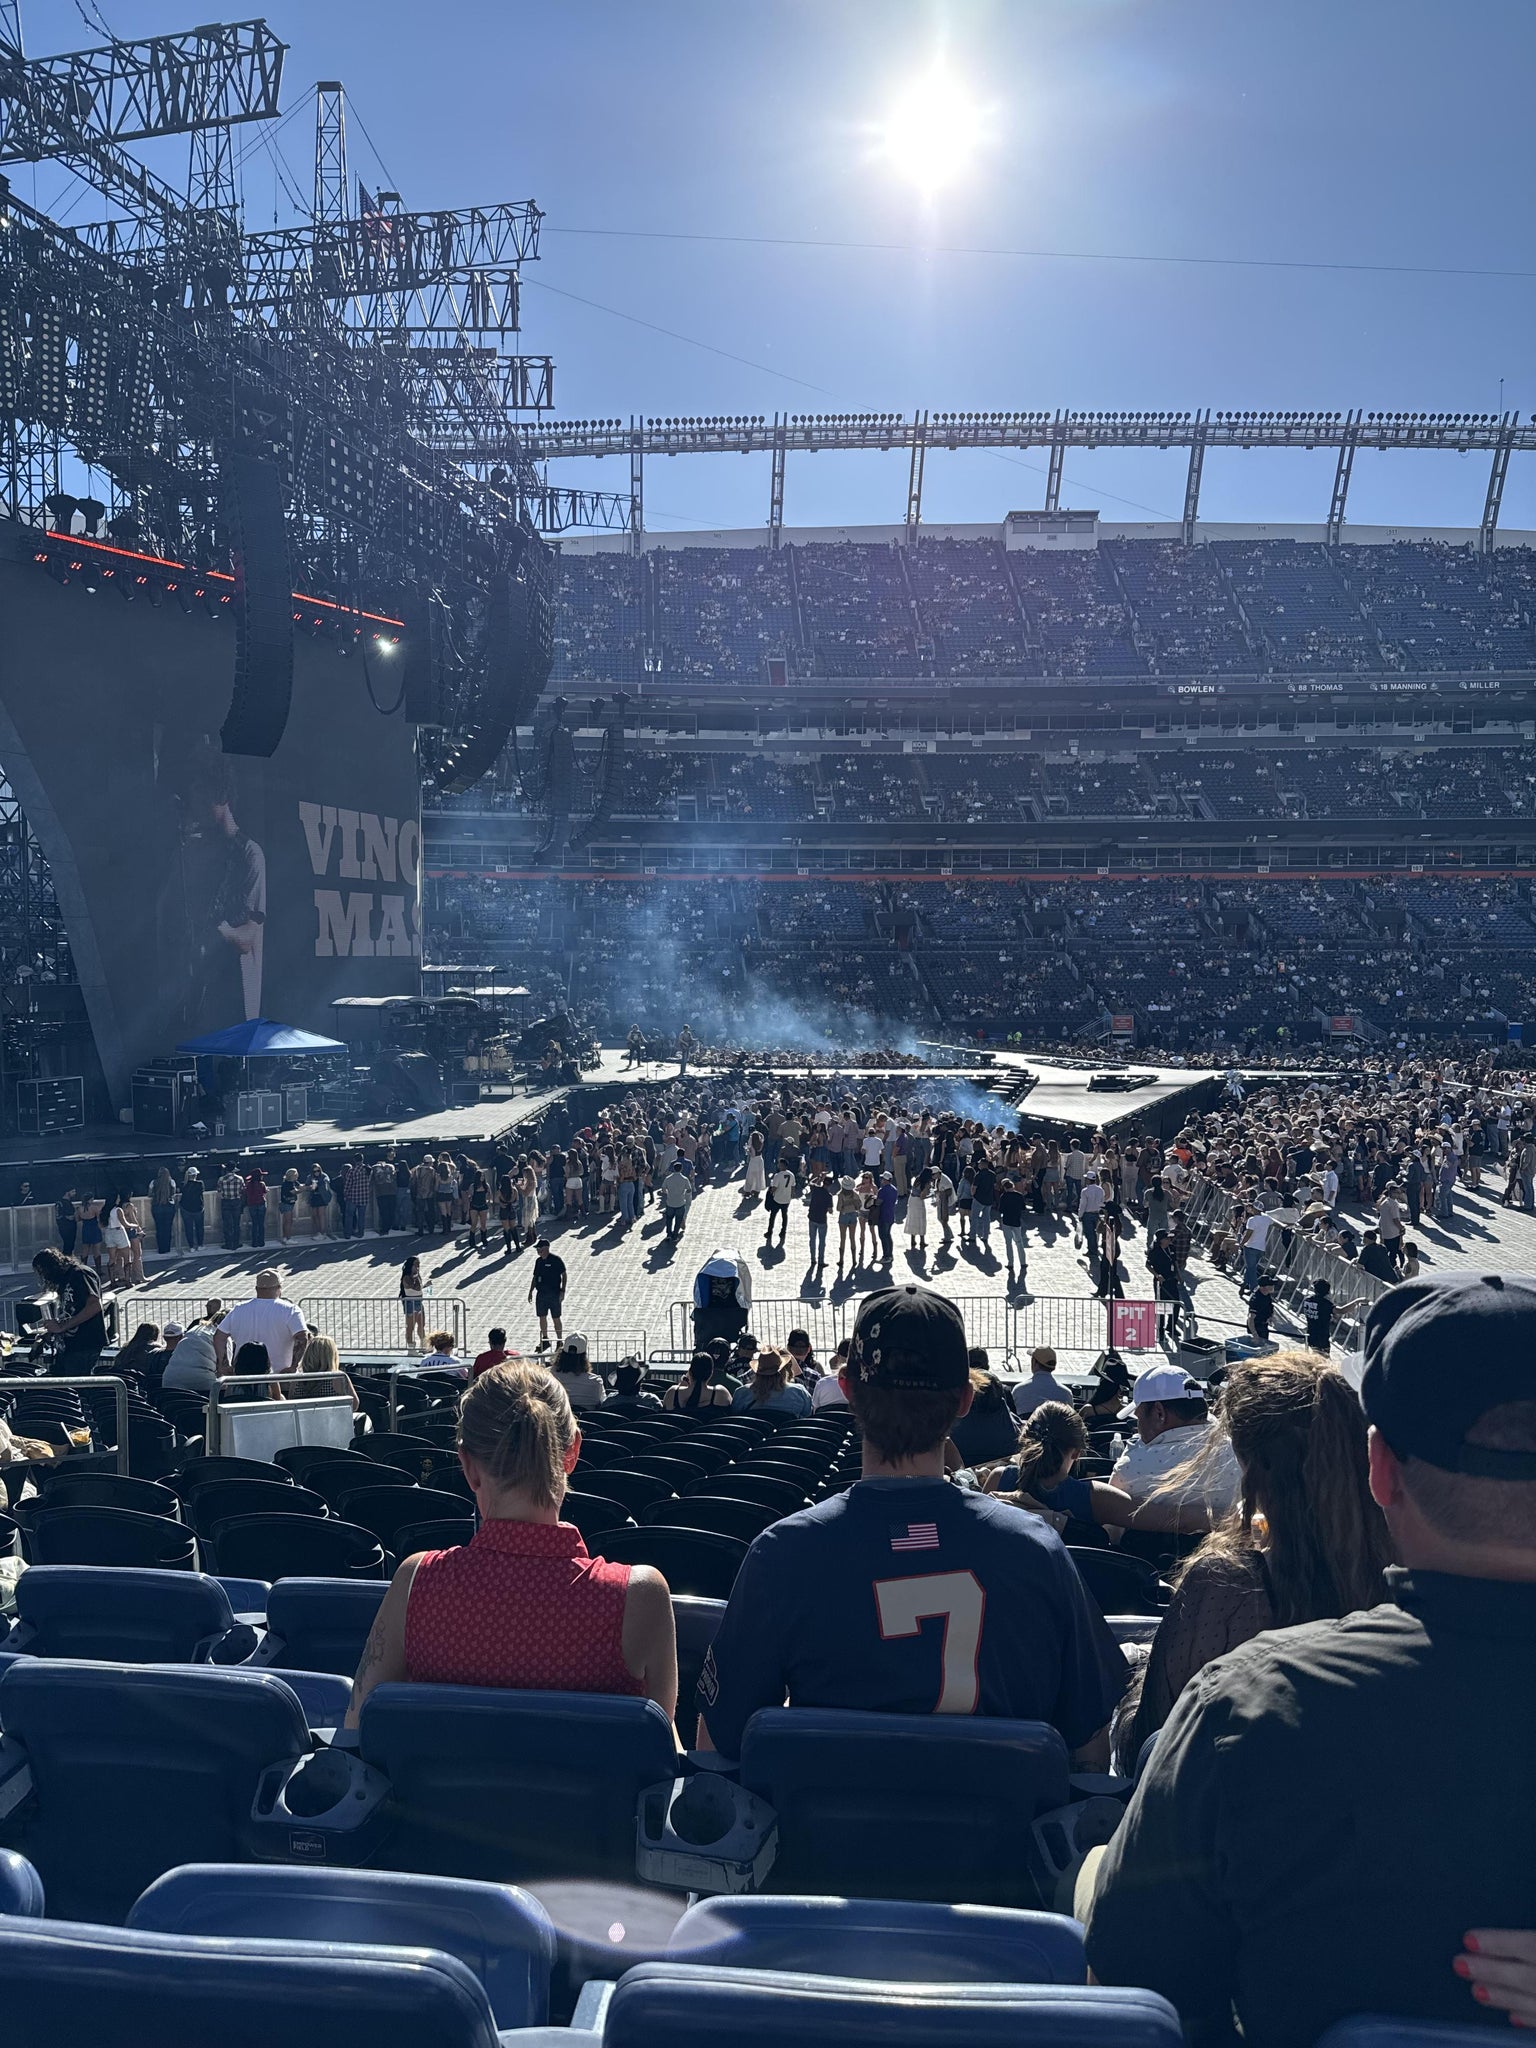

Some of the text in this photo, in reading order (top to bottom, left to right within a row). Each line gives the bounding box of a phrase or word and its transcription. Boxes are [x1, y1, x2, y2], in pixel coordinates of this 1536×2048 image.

[784, 1174, 790, 1188] 7
[1116, 1306, 1146, 1320] PIT
[1125, 1328, 1137, 1341] 2
[872, 1569, 987, 1714] 7
[293, 1841, 322, 1849] EMPOWER
